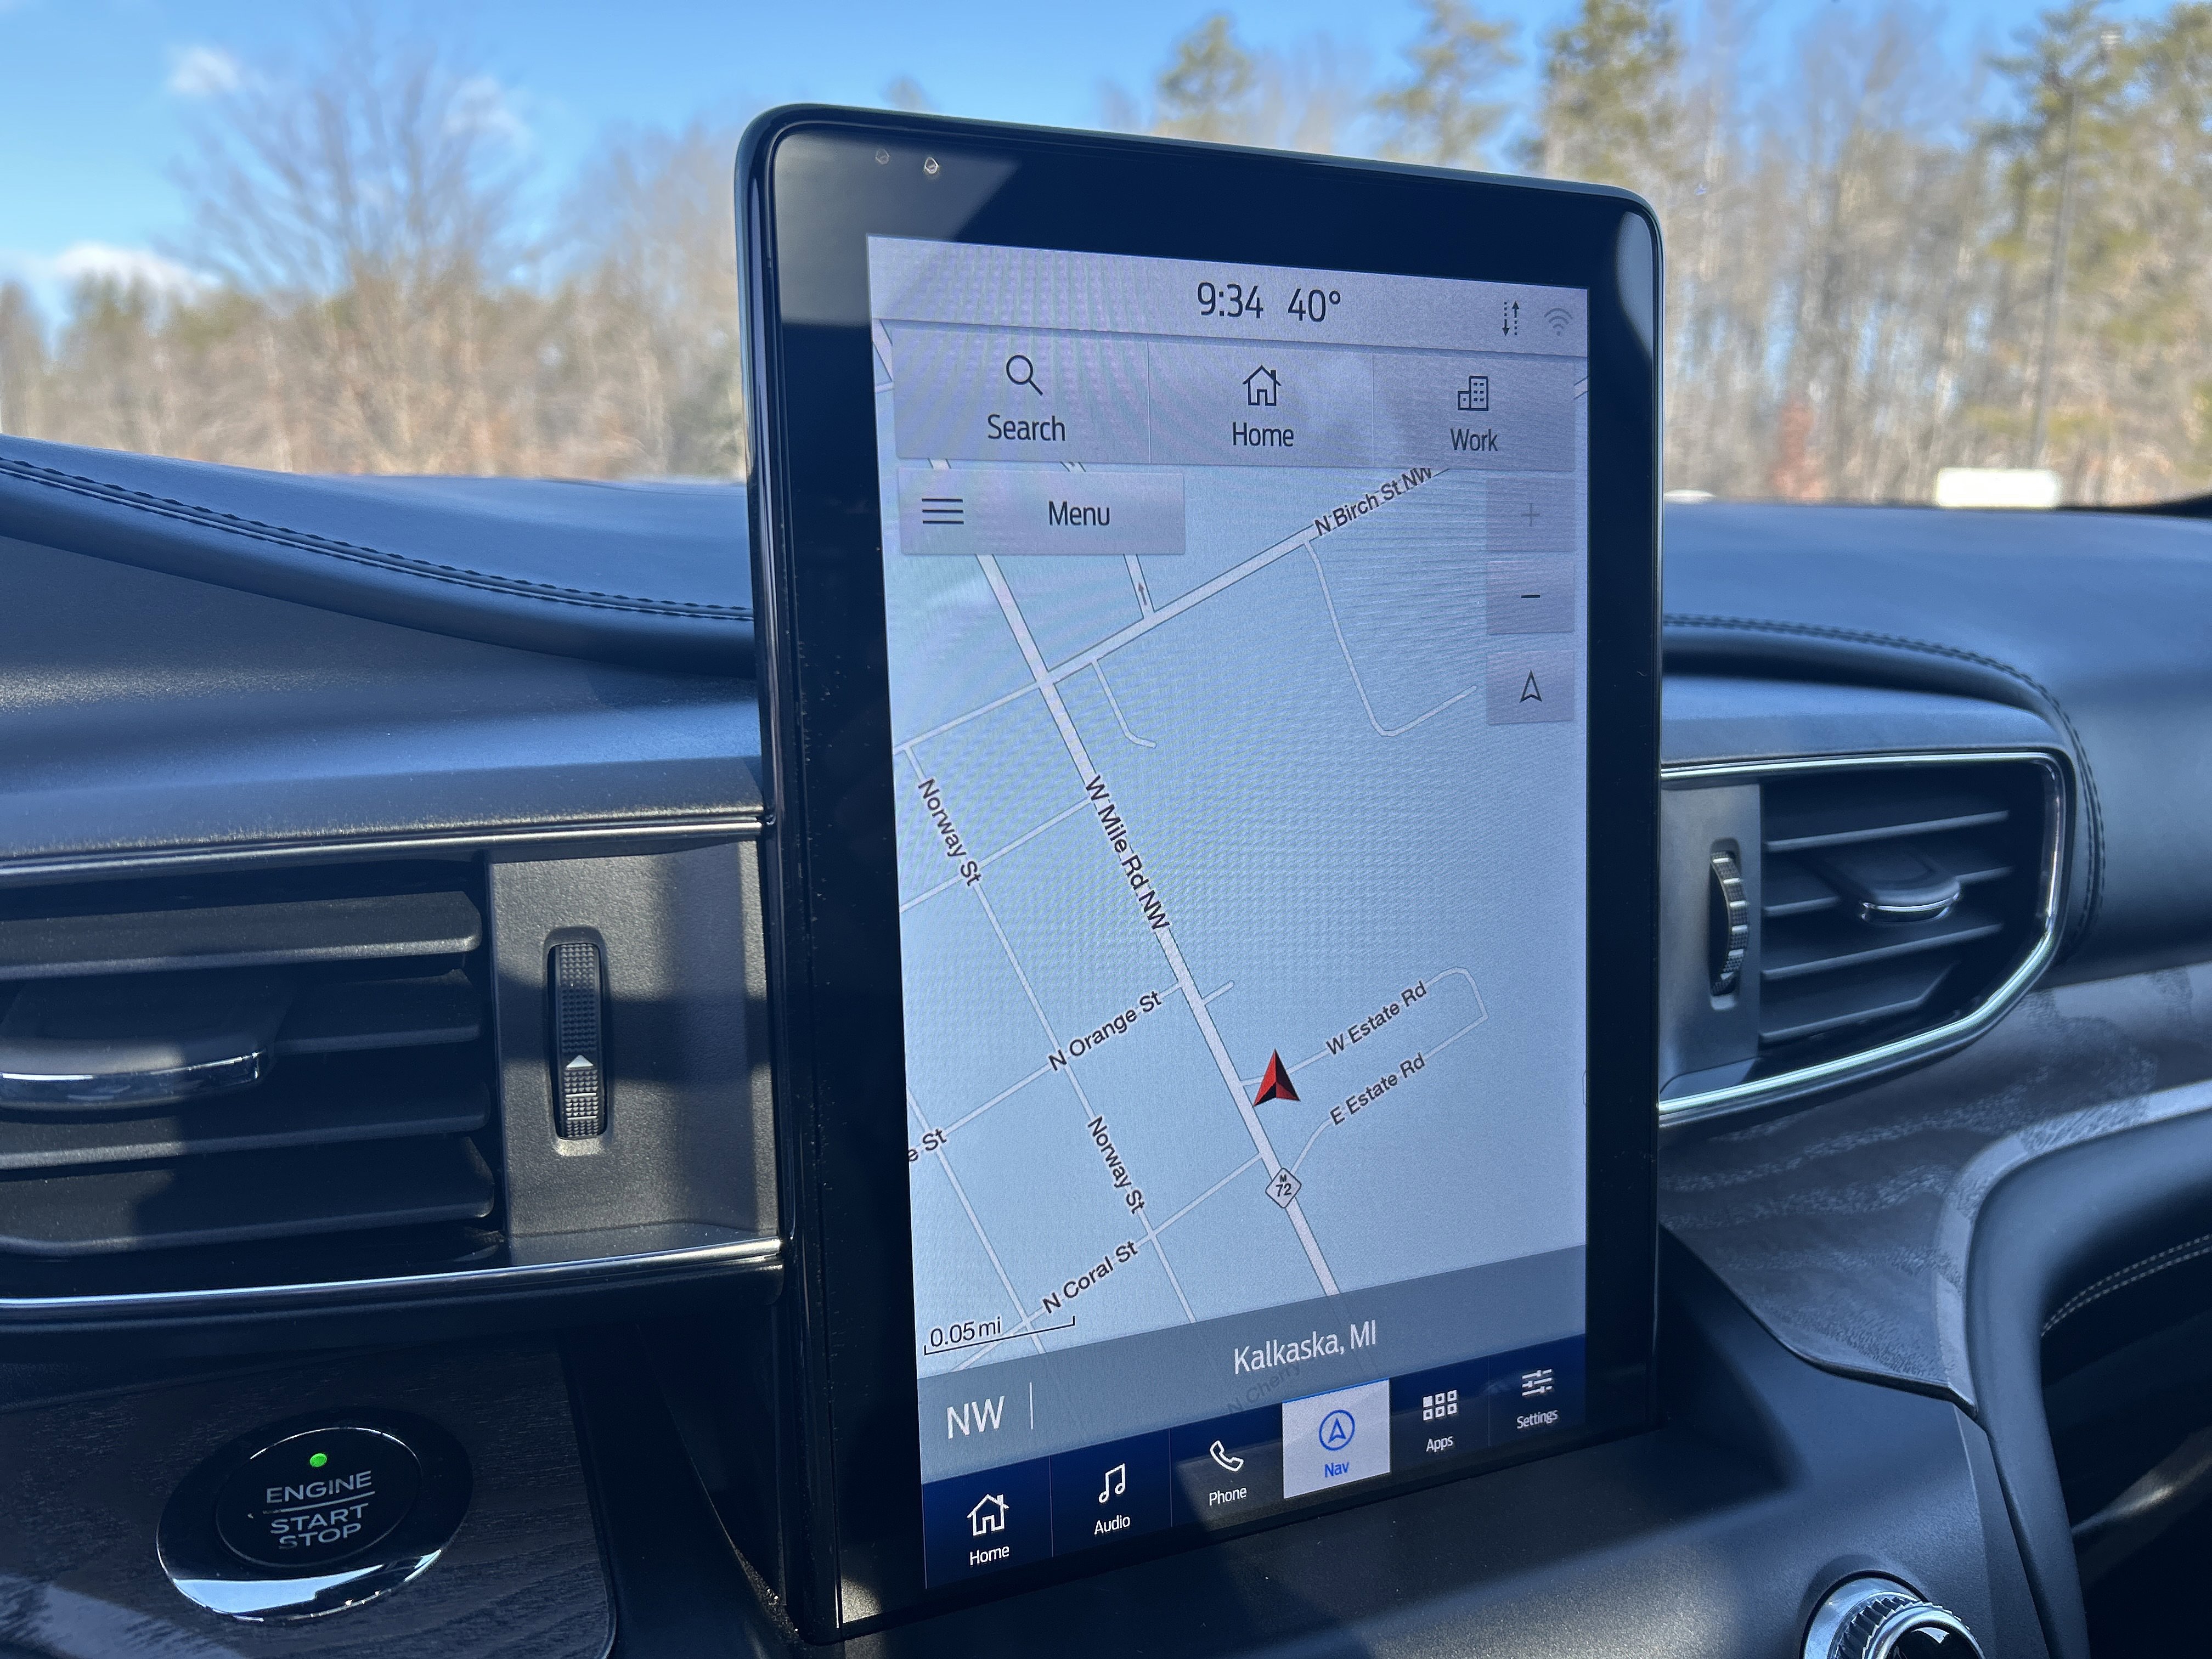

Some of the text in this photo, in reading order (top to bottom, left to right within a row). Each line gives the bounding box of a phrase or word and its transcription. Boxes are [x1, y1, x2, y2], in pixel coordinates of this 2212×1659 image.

[1198, 281, 1341, 322] 9:34 40°
[988, 414, 1066, 442] Search
[1233, 421, 1294, 448] Home
[1450, 428, 1498, 452] Work
[1048, 500, 1110, 527] Menu
[1314, 467, 1432, 537] N Birch St NW
[918, 778, 981, 887] Norway St
[1086, 775, 1171, 932] W Mile Rd NW
[1048, 990, 1163, 1071] N Orange St
[1326, 980, 1427, 1055] W Estate Rd
[1330, 1052, 1426, 1126] E Estate Rd
[922, 1128, 947, 1151] St
[1088, 1116, 1146, 1214] Norway St
[1280, 1174, 1287, 1182] M
[1276, 1183, 1292, 1197] 72
[1042, 1241, 1138, 1314] N Coral St
[930, 1316, 1002, 1347] 0.05 mi
[1234, 1319, 1376, 1375] Kalkaska, MI
[1228, 1364, 1301, 1413] N Cherry
[946, 1395, 1005, 1439] NW
[1516, 1408, 1559, 1429] Settings
[1426, 1434, 1454, 1453] Apps
[1324, 1461, 1350, 1478] Nav
[266, 1470, 373, 1504] ENGINE
[1209, 1486, 1248, 1506] Phone
[270, 1502, 369, 1535] START
[1094, 1515, 1131, 1536] Audio
[278, 1522, 362, 1550] STOP
[969, 1545, 1010, 1566] Home
